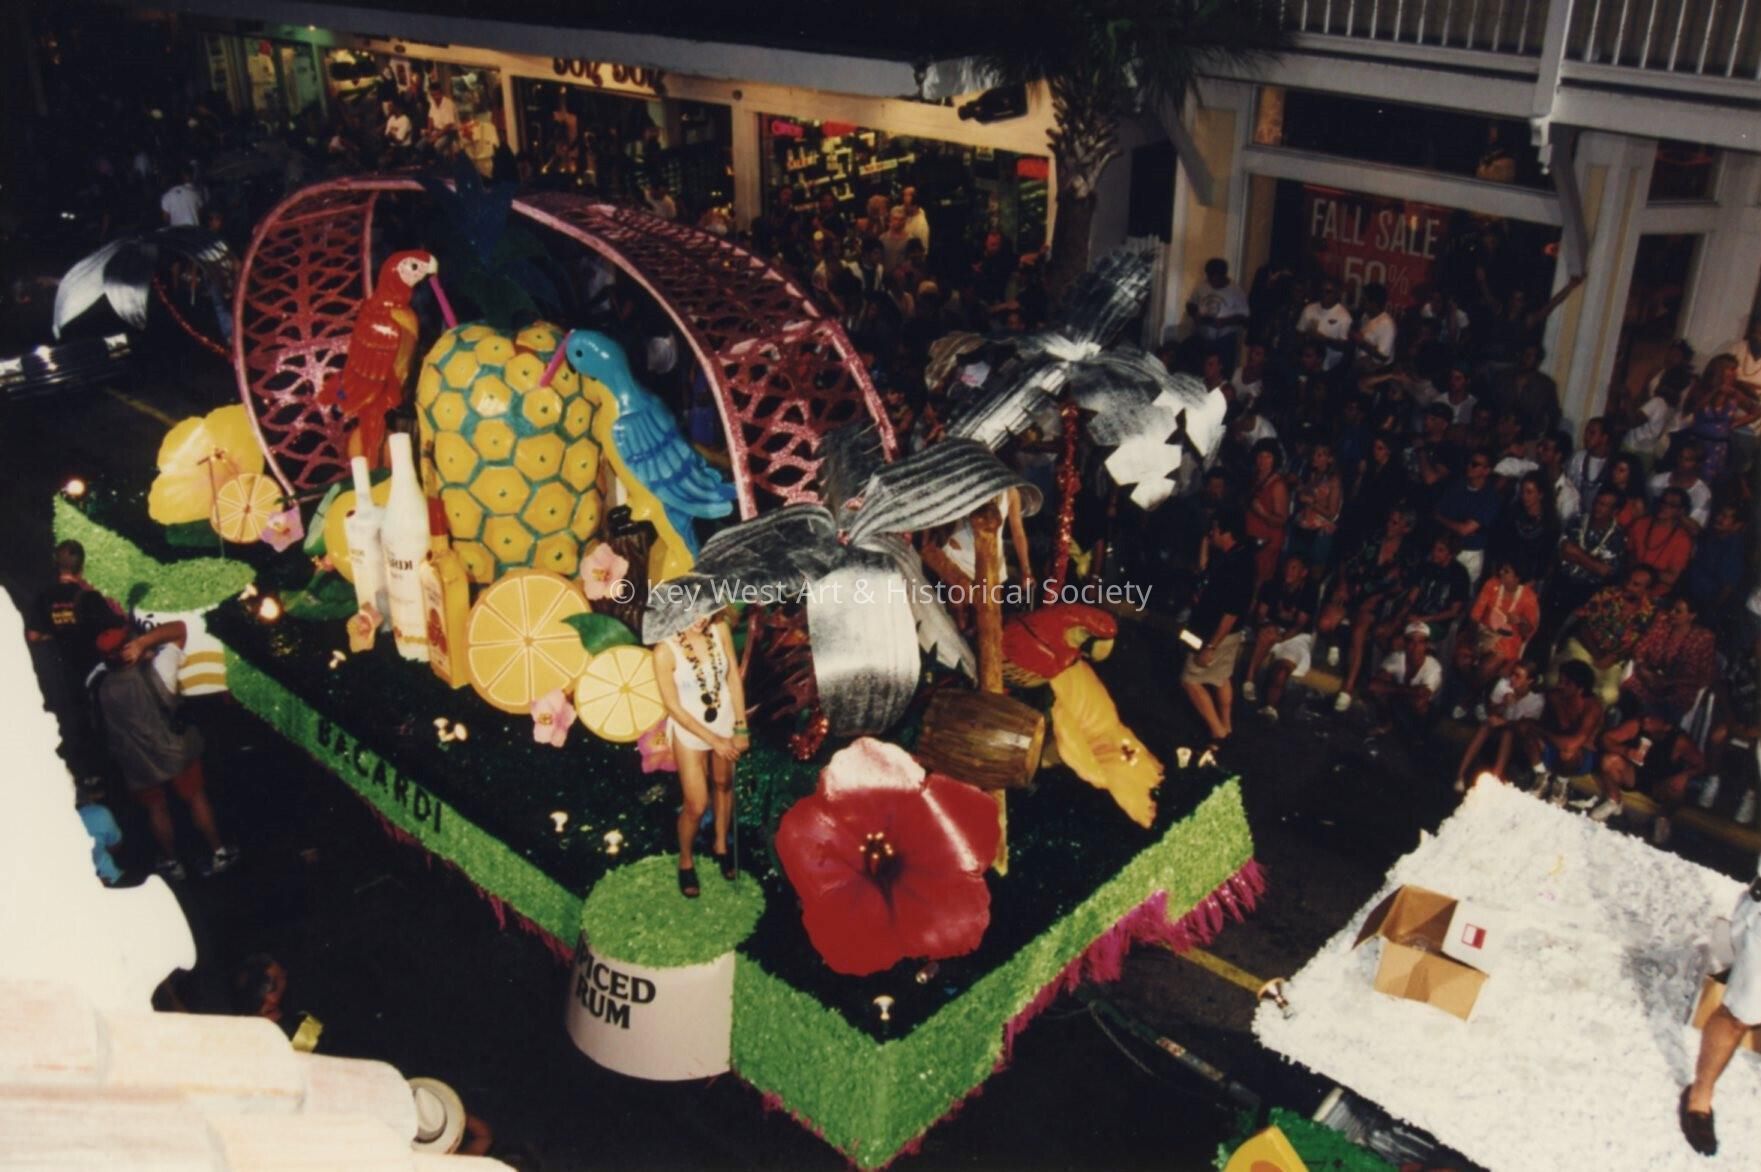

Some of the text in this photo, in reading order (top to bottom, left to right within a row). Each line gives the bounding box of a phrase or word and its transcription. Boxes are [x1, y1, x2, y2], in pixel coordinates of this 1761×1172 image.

[1311, 197, 1441, 261] FALL SALE
[576, 974, 631, 1030] RUM
